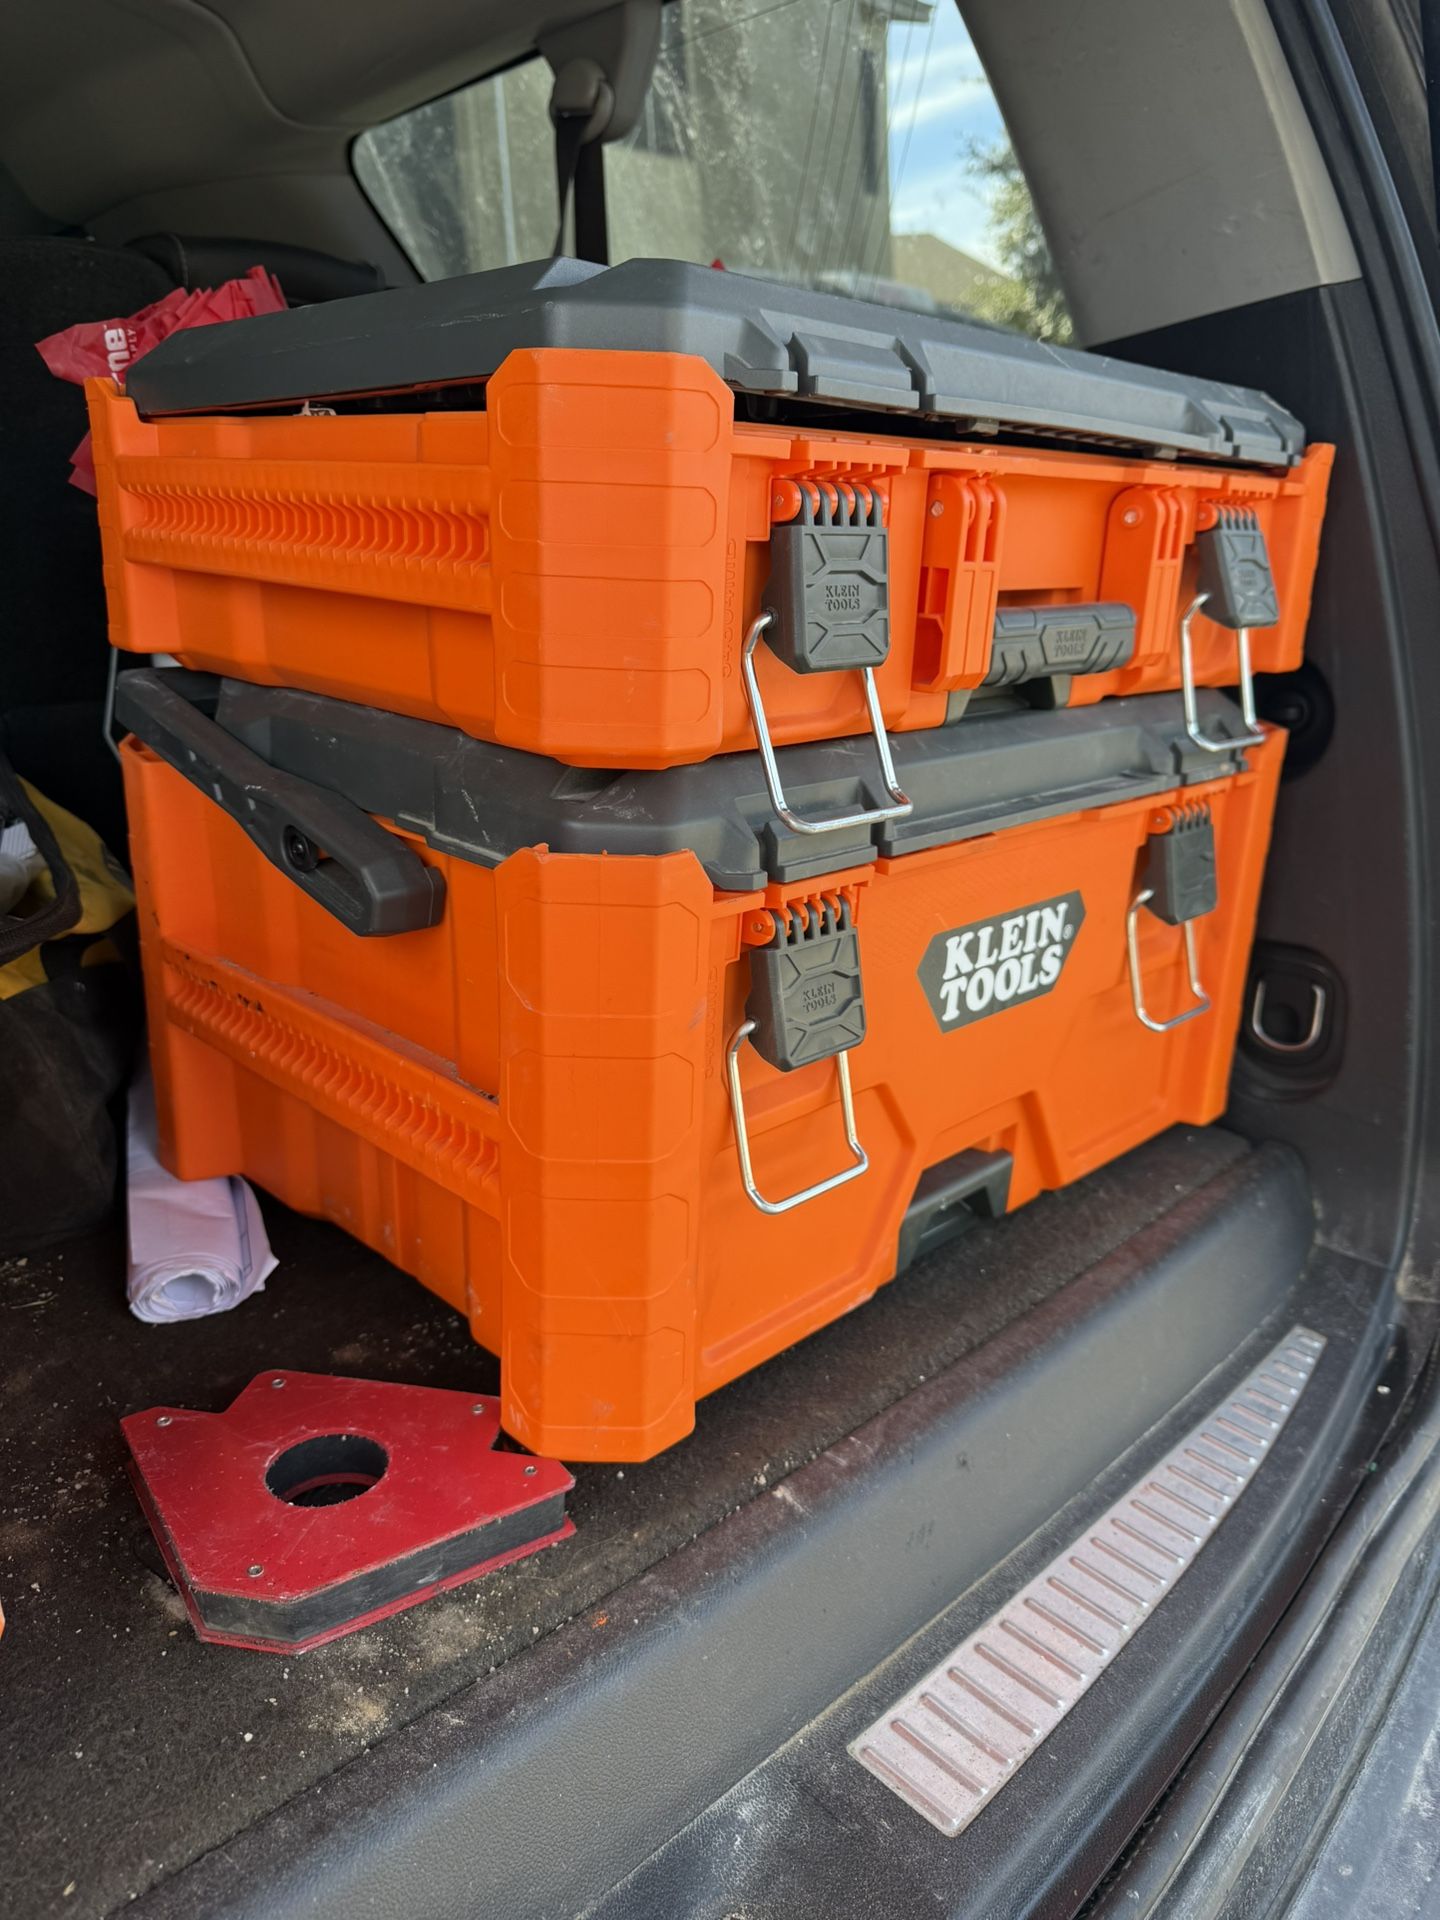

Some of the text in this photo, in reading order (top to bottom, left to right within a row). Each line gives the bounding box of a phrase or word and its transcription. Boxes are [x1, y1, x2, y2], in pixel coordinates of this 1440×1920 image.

[825, 584, 860, 598] KLEIN
[825, 598, 860, 611] TOOLS
[802, 982, 835, 1001] KLEIN
[939, 943, 1064, 1022] TOOLS
[802, 994, 837, 1013] TOOLS
